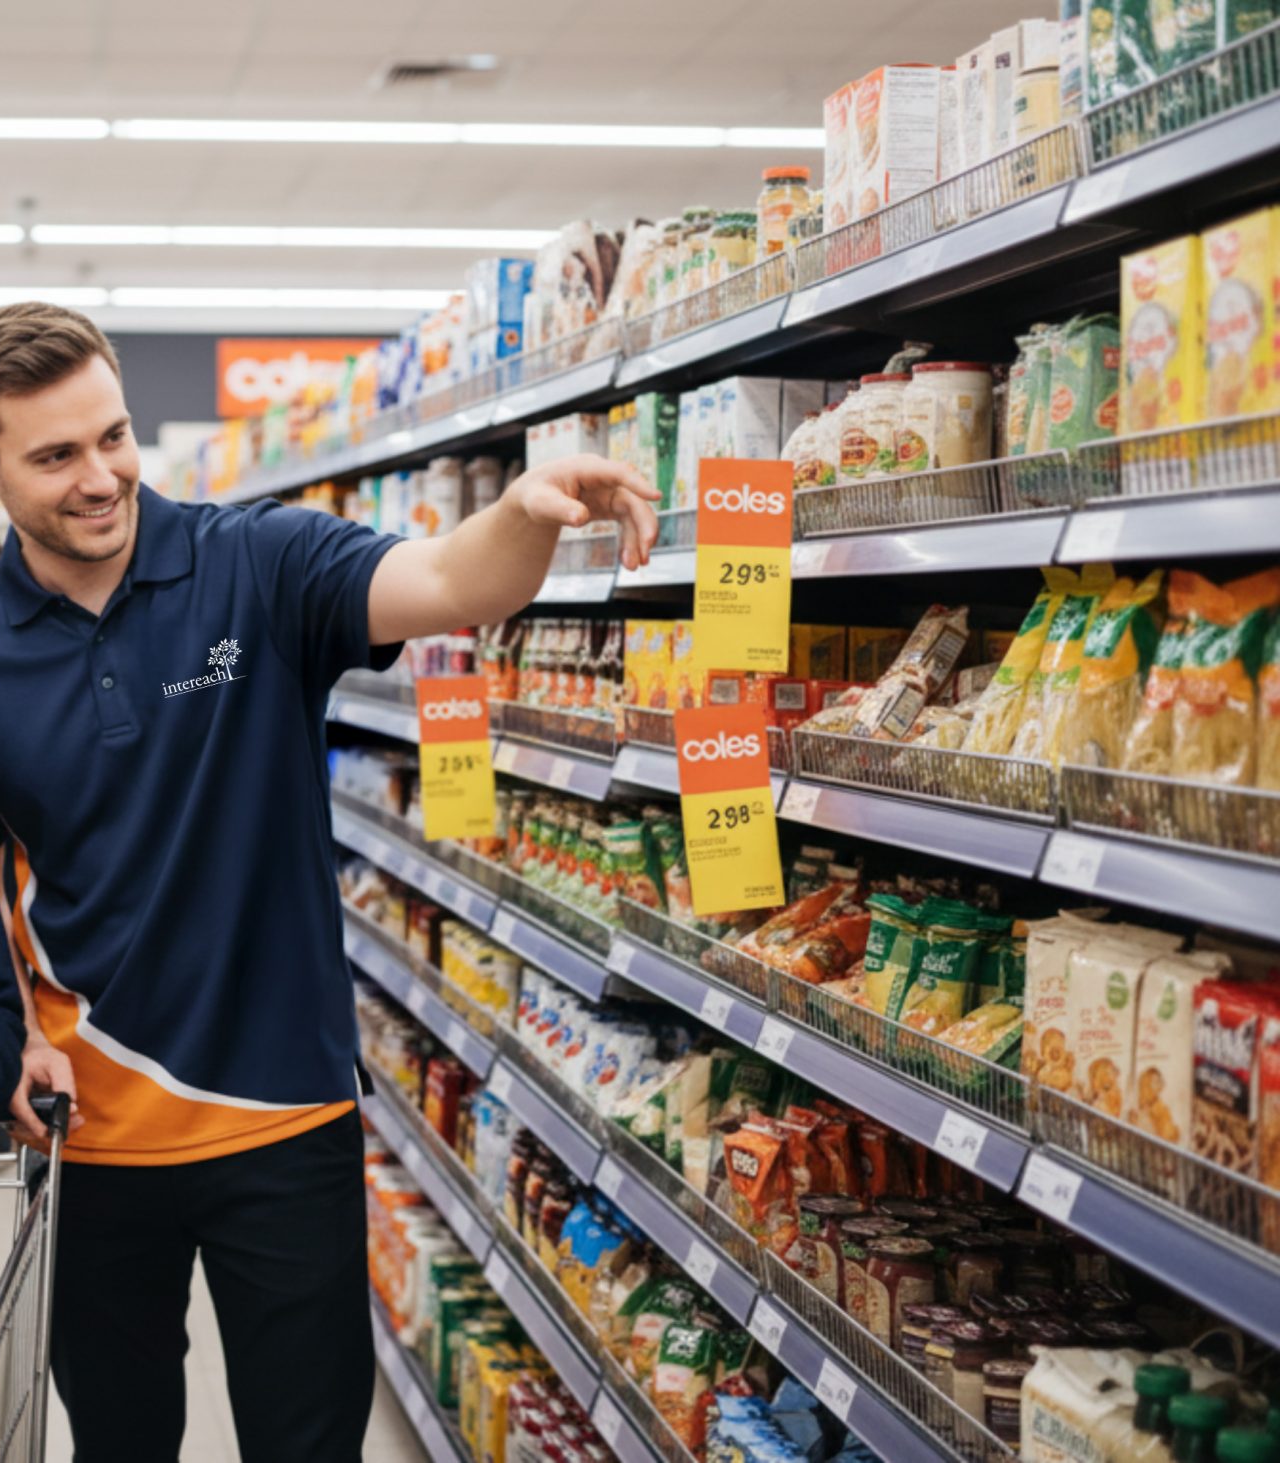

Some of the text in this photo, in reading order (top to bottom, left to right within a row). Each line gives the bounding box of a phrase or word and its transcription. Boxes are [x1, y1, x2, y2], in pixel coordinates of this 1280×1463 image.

[704, 483, 785, 515] coles
[162, 666, 227, 696] intereach
[423, 696, 483, 721] coles
[682, 731, 761, 762] coles
